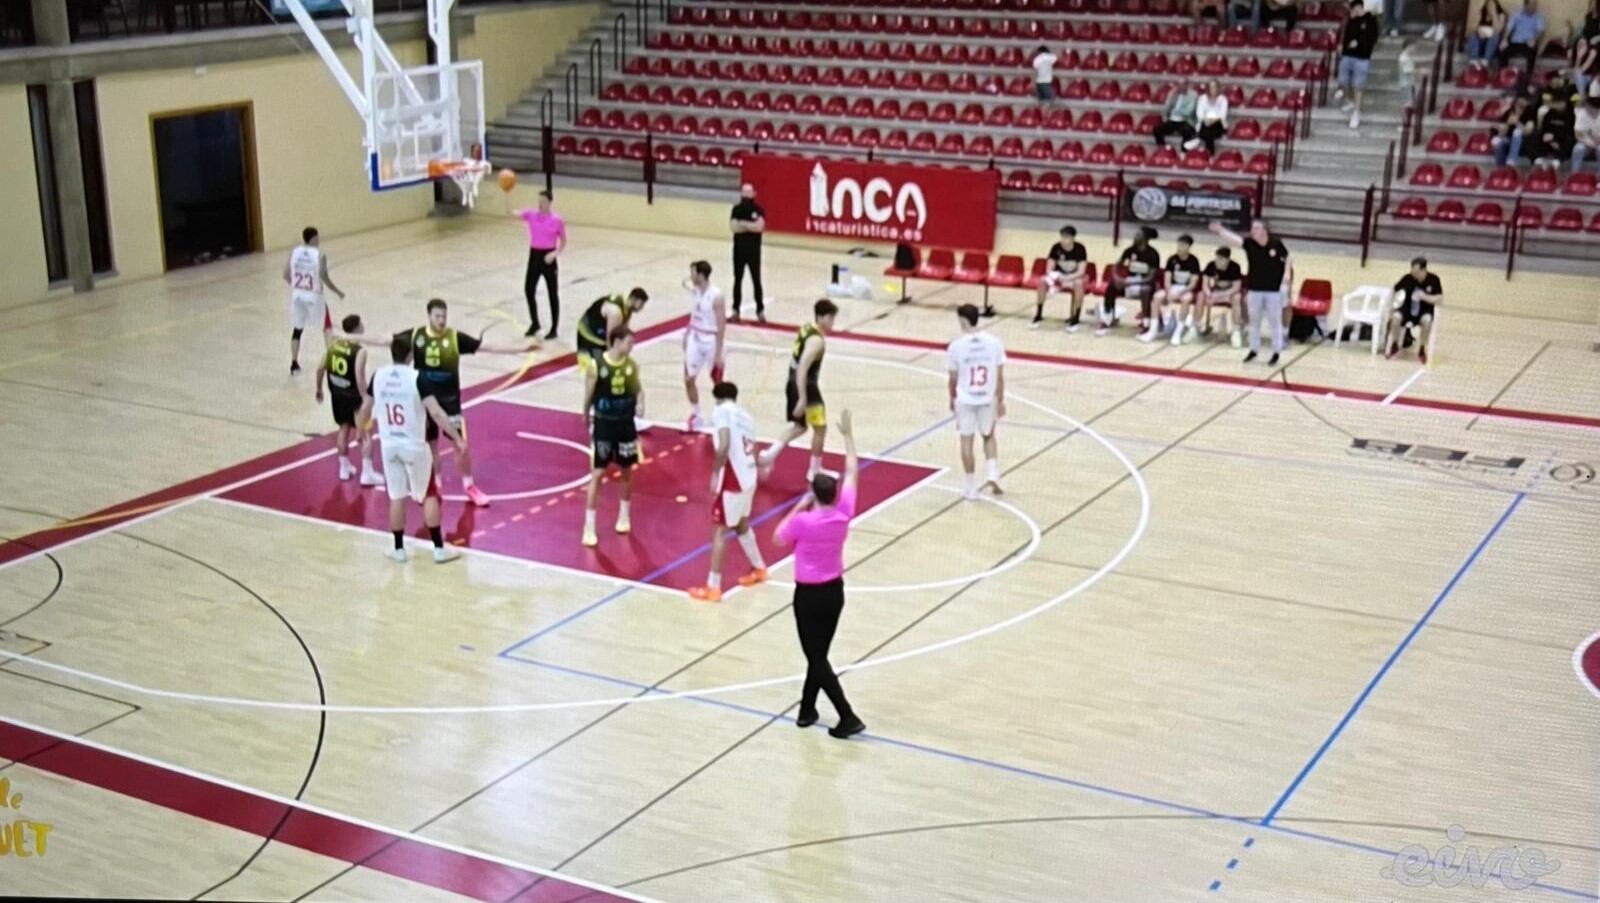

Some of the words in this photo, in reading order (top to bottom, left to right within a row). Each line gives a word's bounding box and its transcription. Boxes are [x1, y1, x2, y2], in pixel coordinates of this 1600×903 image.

[805, 217, 922, 241] incaturistica.es
[294, 271, 314, 291] 23
[331, 355, 348, 376] 10
[969, 365, 988, 387] 13
[385, 403, 406, 426] 16
